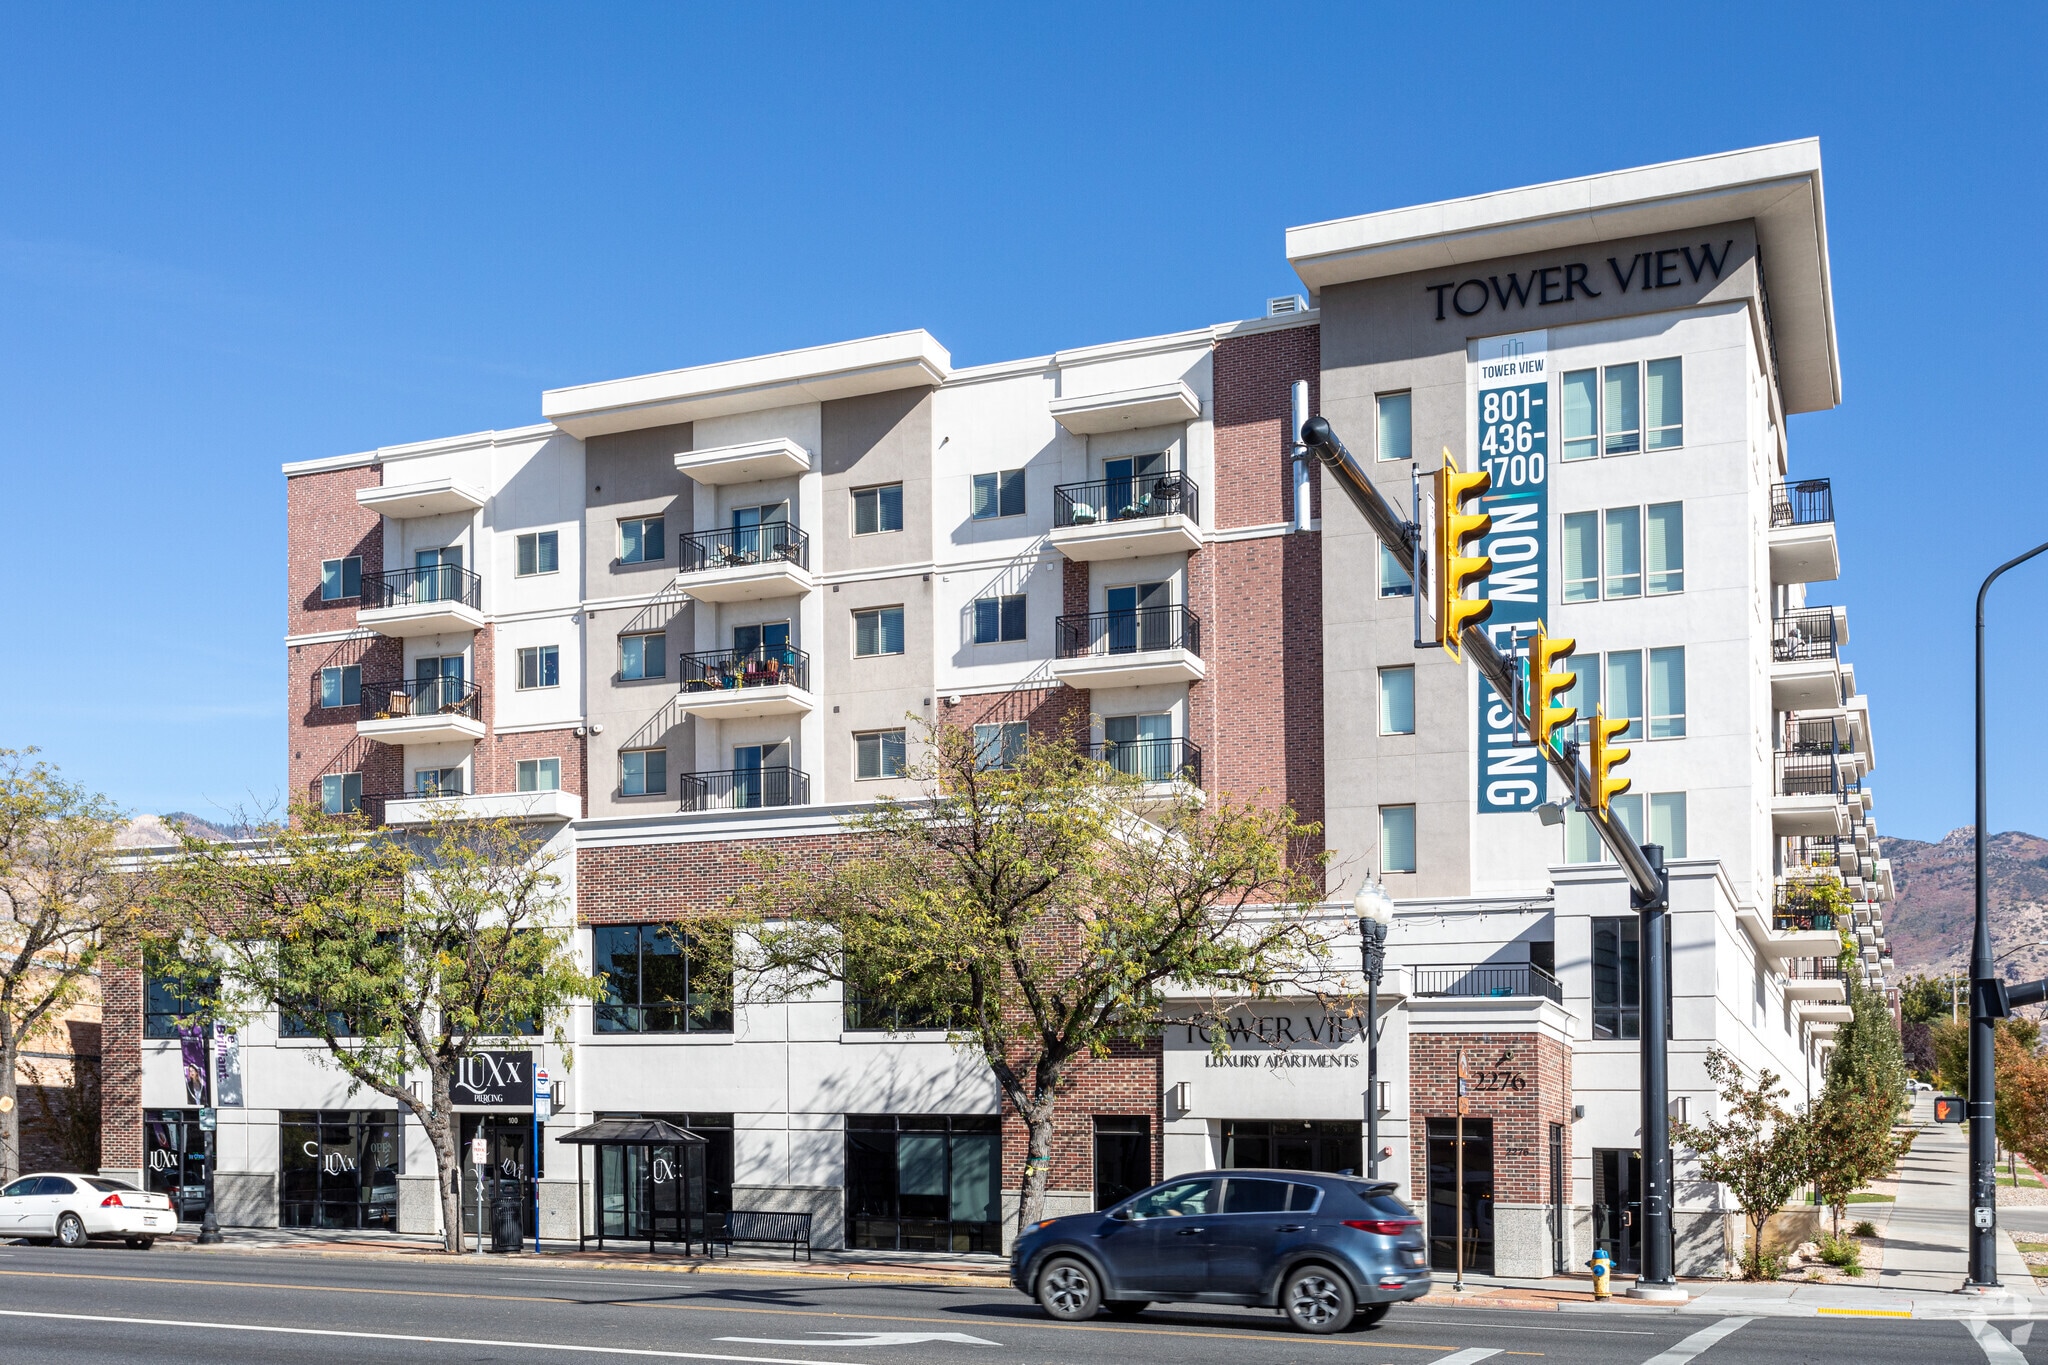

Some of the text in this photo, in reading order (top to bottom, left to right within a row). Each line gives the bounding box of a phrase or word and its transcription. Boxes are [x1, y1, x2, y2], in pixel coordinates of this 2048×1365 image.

[1426, 239, 1734, 321] TOWER VIEW
[1482, 359, 1544, 379] TOWER VIEW
[1483, 388, 1544, 424] 801-
[1481, 421, 1545, 456] 436-
[1487, 503, 1540, 604] NOW
[1204, 1053, 1360, 1069] LUXURY APARTMENTS
[1471, 1071, 1526, 1092] 2276
[474, 1093, 504, 1104] PIERCING
[508, 1116, 519, 1125] 100
[1506, 1148, 1529, 1157] 2276
